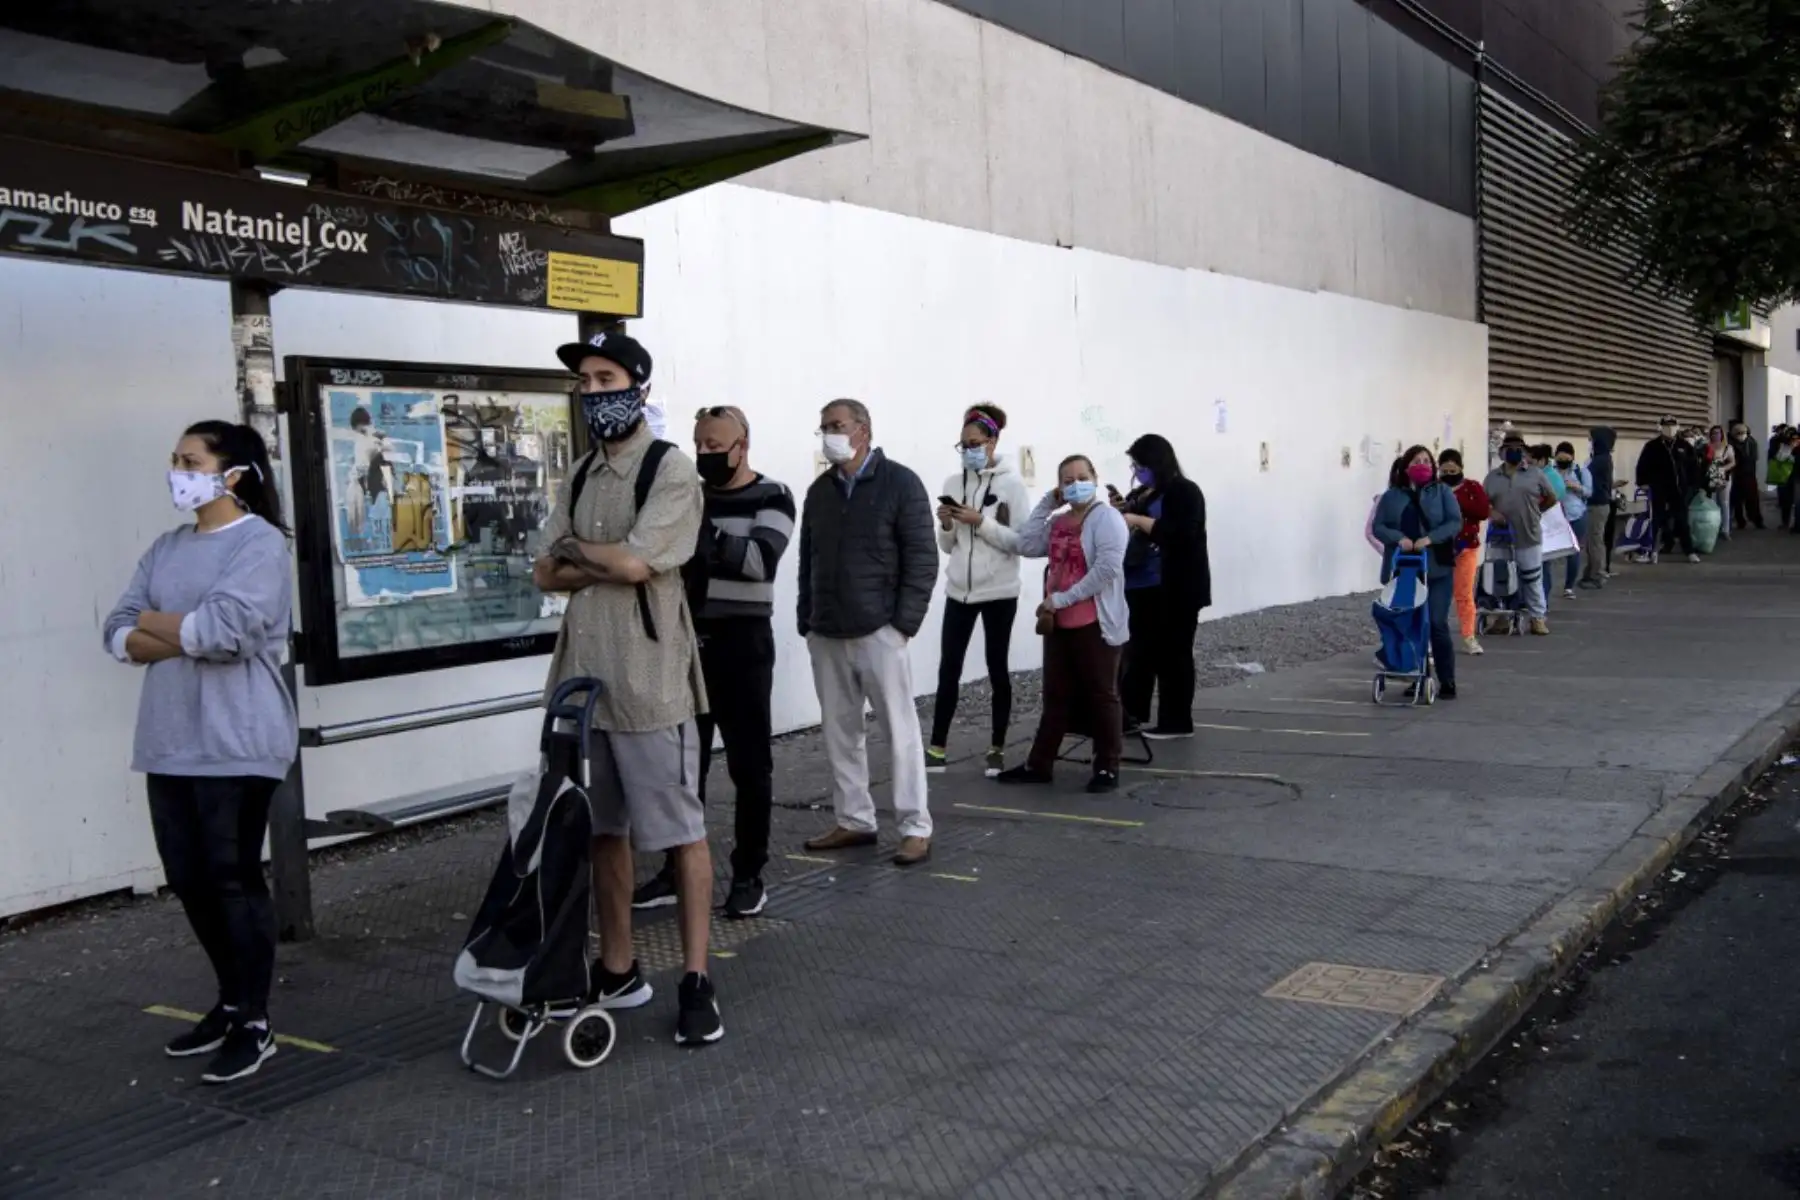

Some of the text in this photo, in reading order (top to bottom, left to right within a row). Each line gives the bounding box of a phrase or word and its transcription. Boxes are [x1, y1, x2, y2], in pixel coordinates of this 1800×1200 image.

[0, 186, 122, 221] amachuco
[182, 200, 312, 248] Nataniel
[319, 221, 369, 253] Cox
